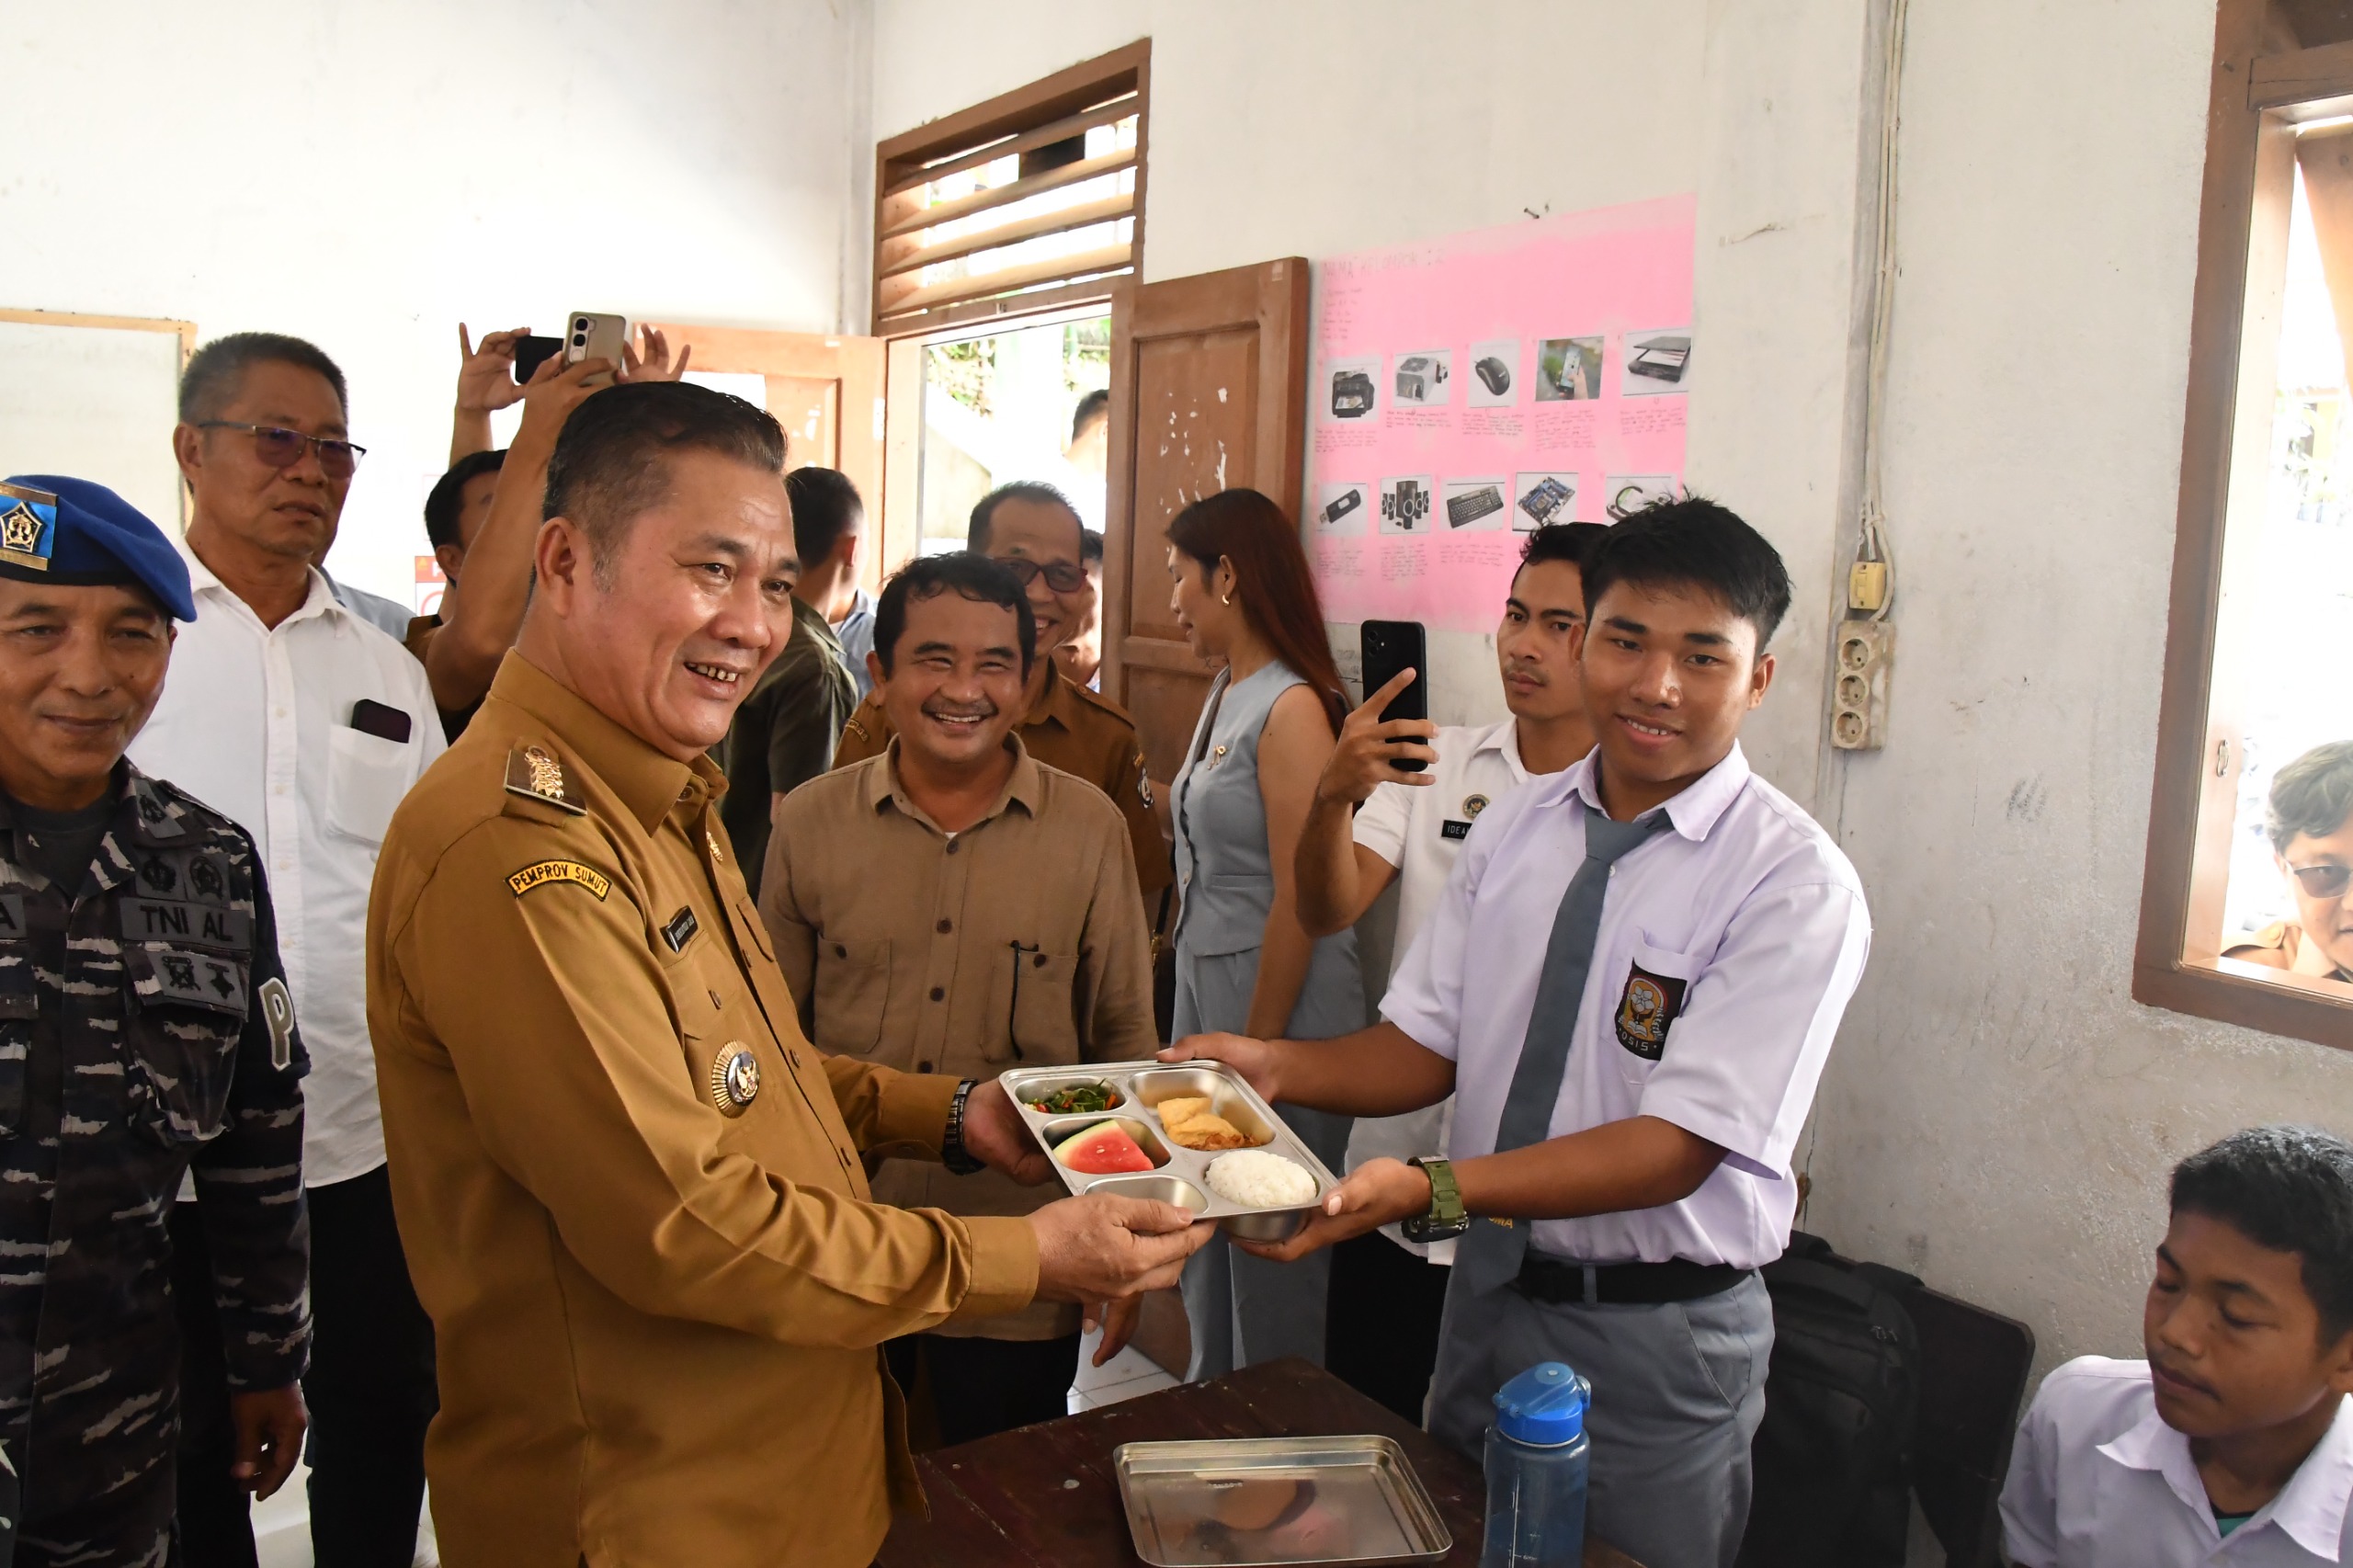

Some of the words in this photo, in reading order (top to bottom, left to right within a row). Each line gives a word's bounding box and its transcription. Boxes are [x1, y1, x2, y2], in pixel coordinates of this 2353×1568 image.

[512, 864, 568, 891] PEMPROV
[575, 867, 608, 892] SUMUT
[140, 905, 189, 934] TNI
[202, 915, 233, 942] AL
[1621, 1030, 1649, 1051] OSIS
